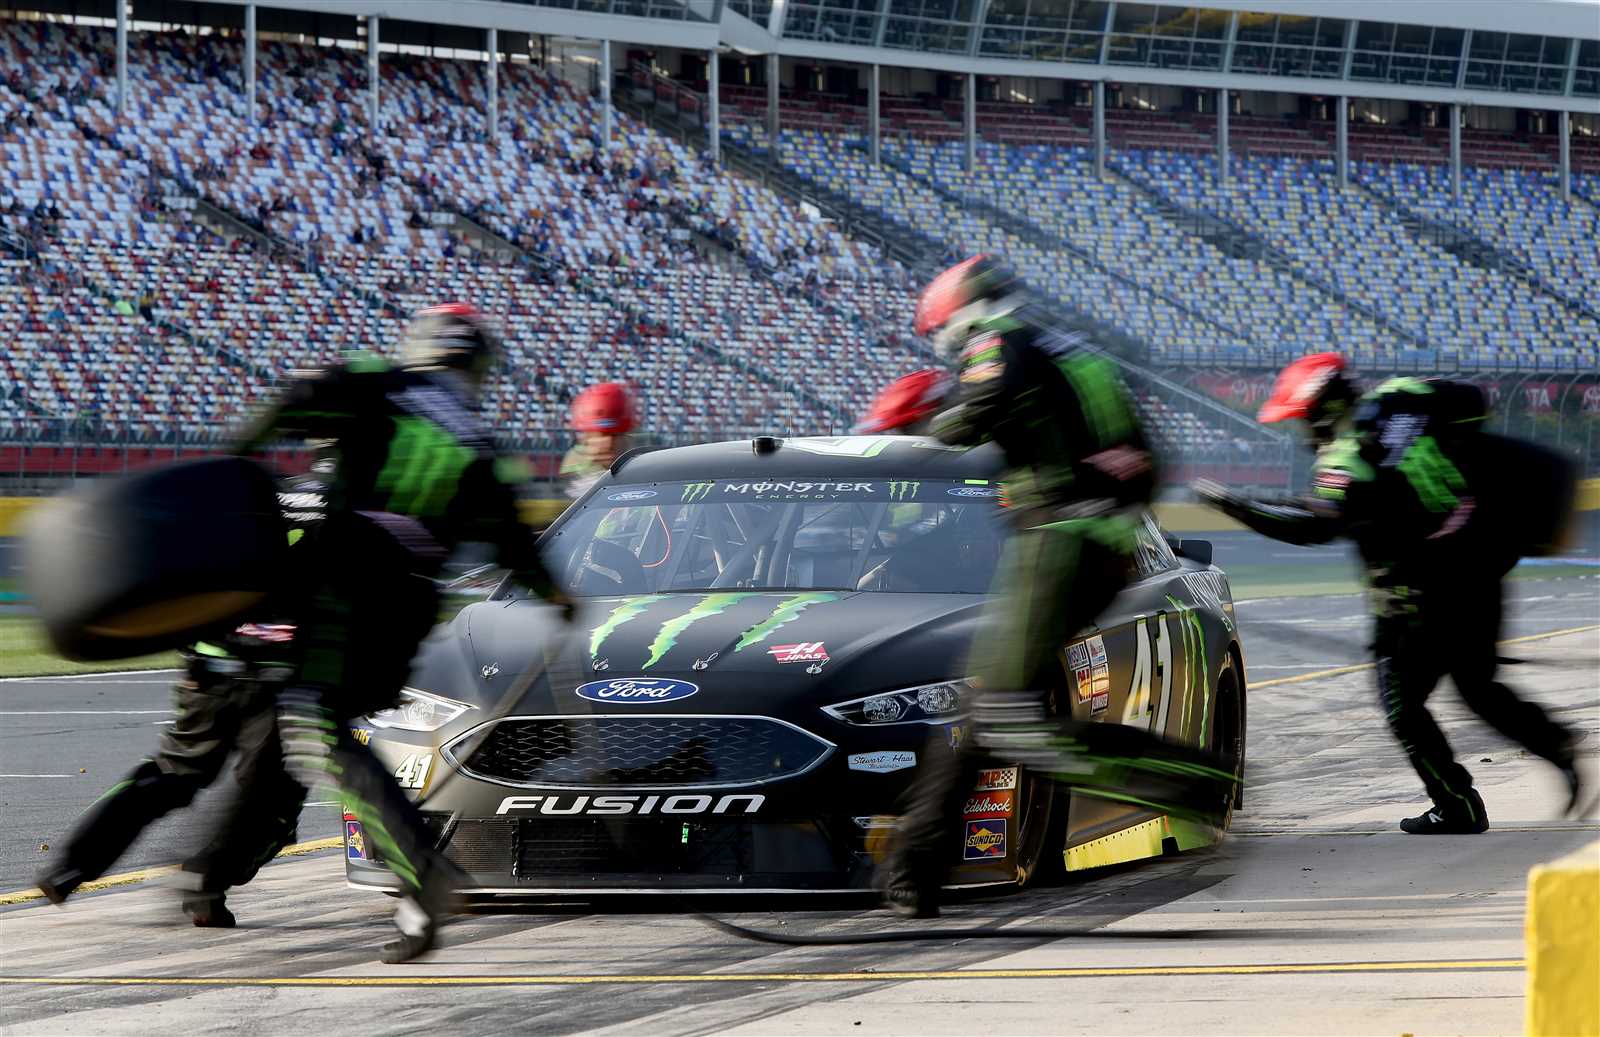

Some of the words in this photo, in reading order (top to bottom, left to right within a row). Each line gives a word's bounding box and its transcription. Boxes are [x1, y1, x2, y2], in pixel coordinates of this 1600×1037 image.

[723, 481, 875, 493] MONSTER
[1121, 614, 1173, 739] 41
[598, 680, 676, 698] Ford
[394, 752, 432, 789] 41
[496, 794, 766, 815] FUSION
[963, 798, 1011, 814] Edelbrock
[968, 834, 1003, 846] SUNOCO
